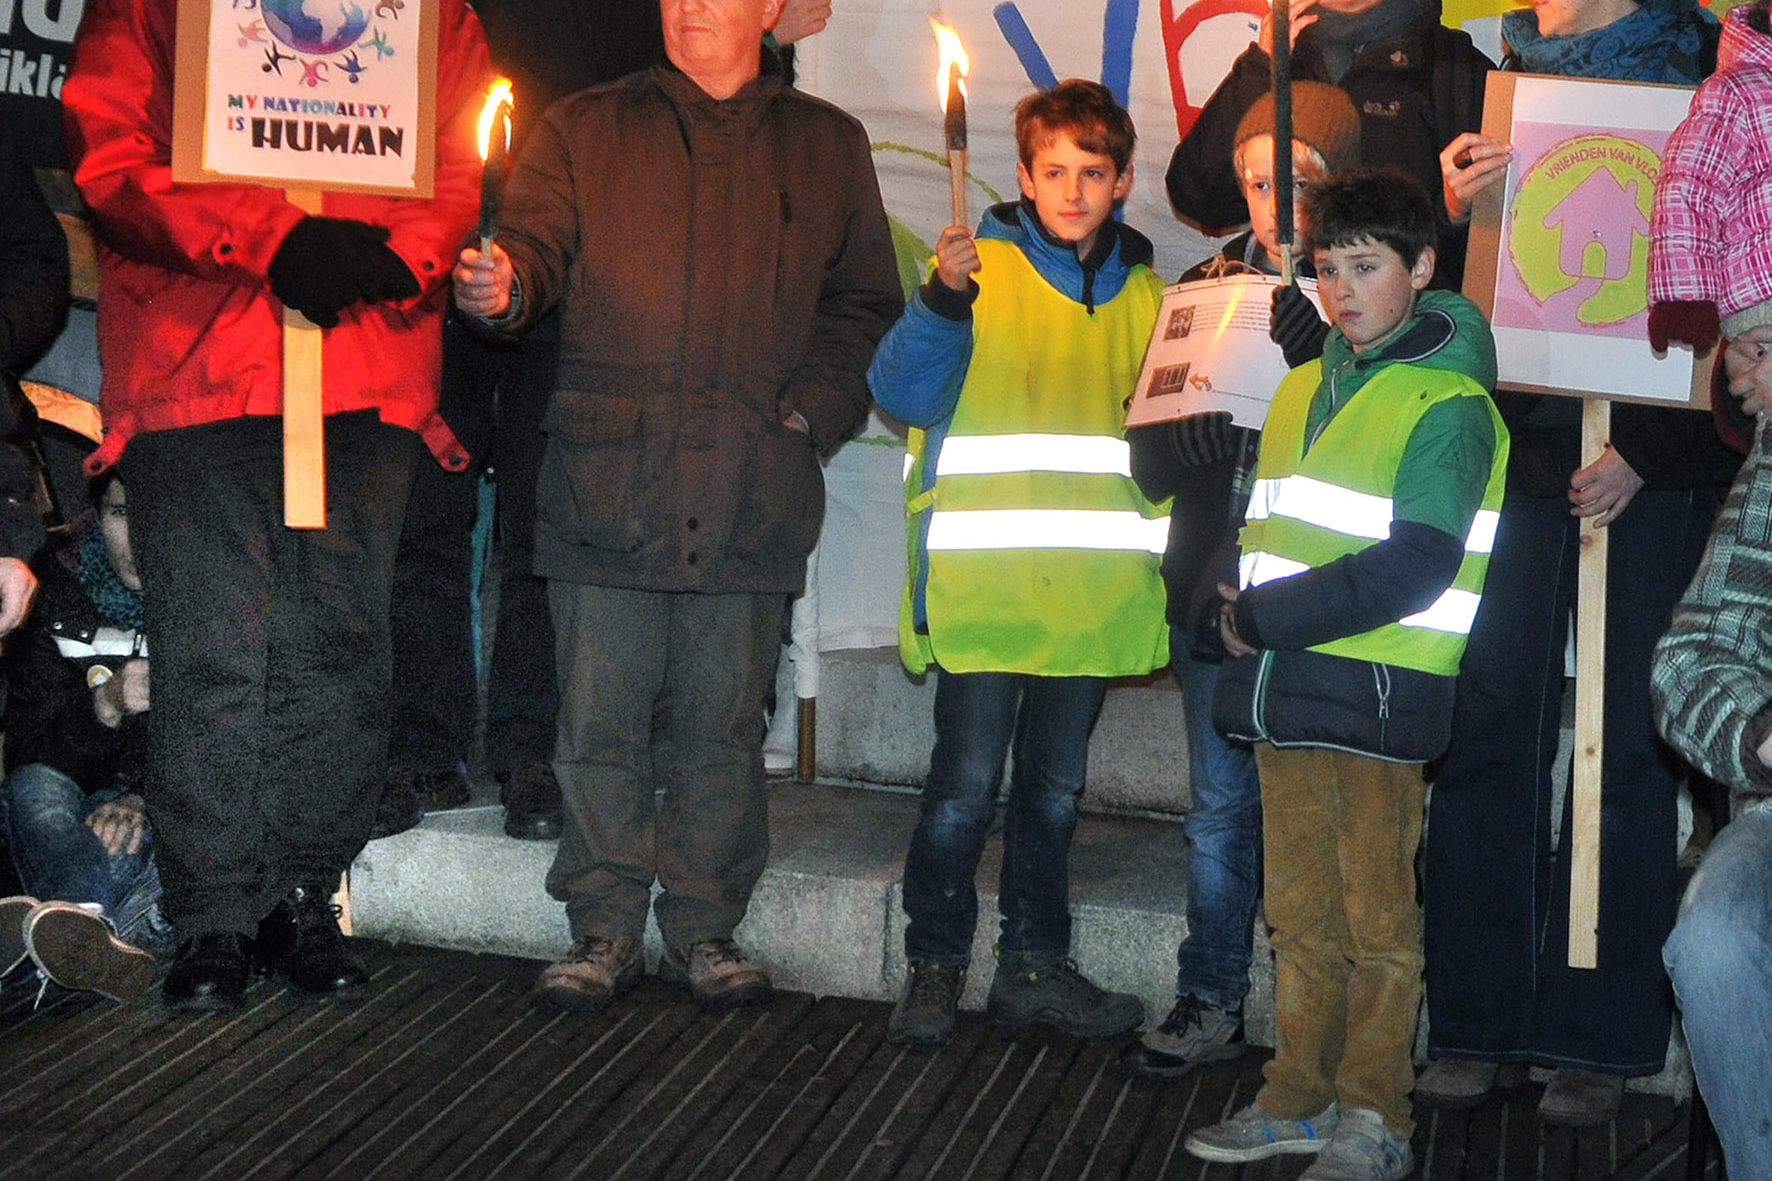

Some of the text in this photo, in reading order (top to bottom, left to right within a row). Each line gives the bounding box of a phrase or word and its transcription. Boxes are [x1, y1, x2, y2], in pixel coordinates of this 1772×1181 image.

[228, 94, 391, 118] MY NATIONALITY
[227, 117, 404, 158] IS HUMAN
[1546, 147, 1659, 183] VRIENDEN VAN VLO
